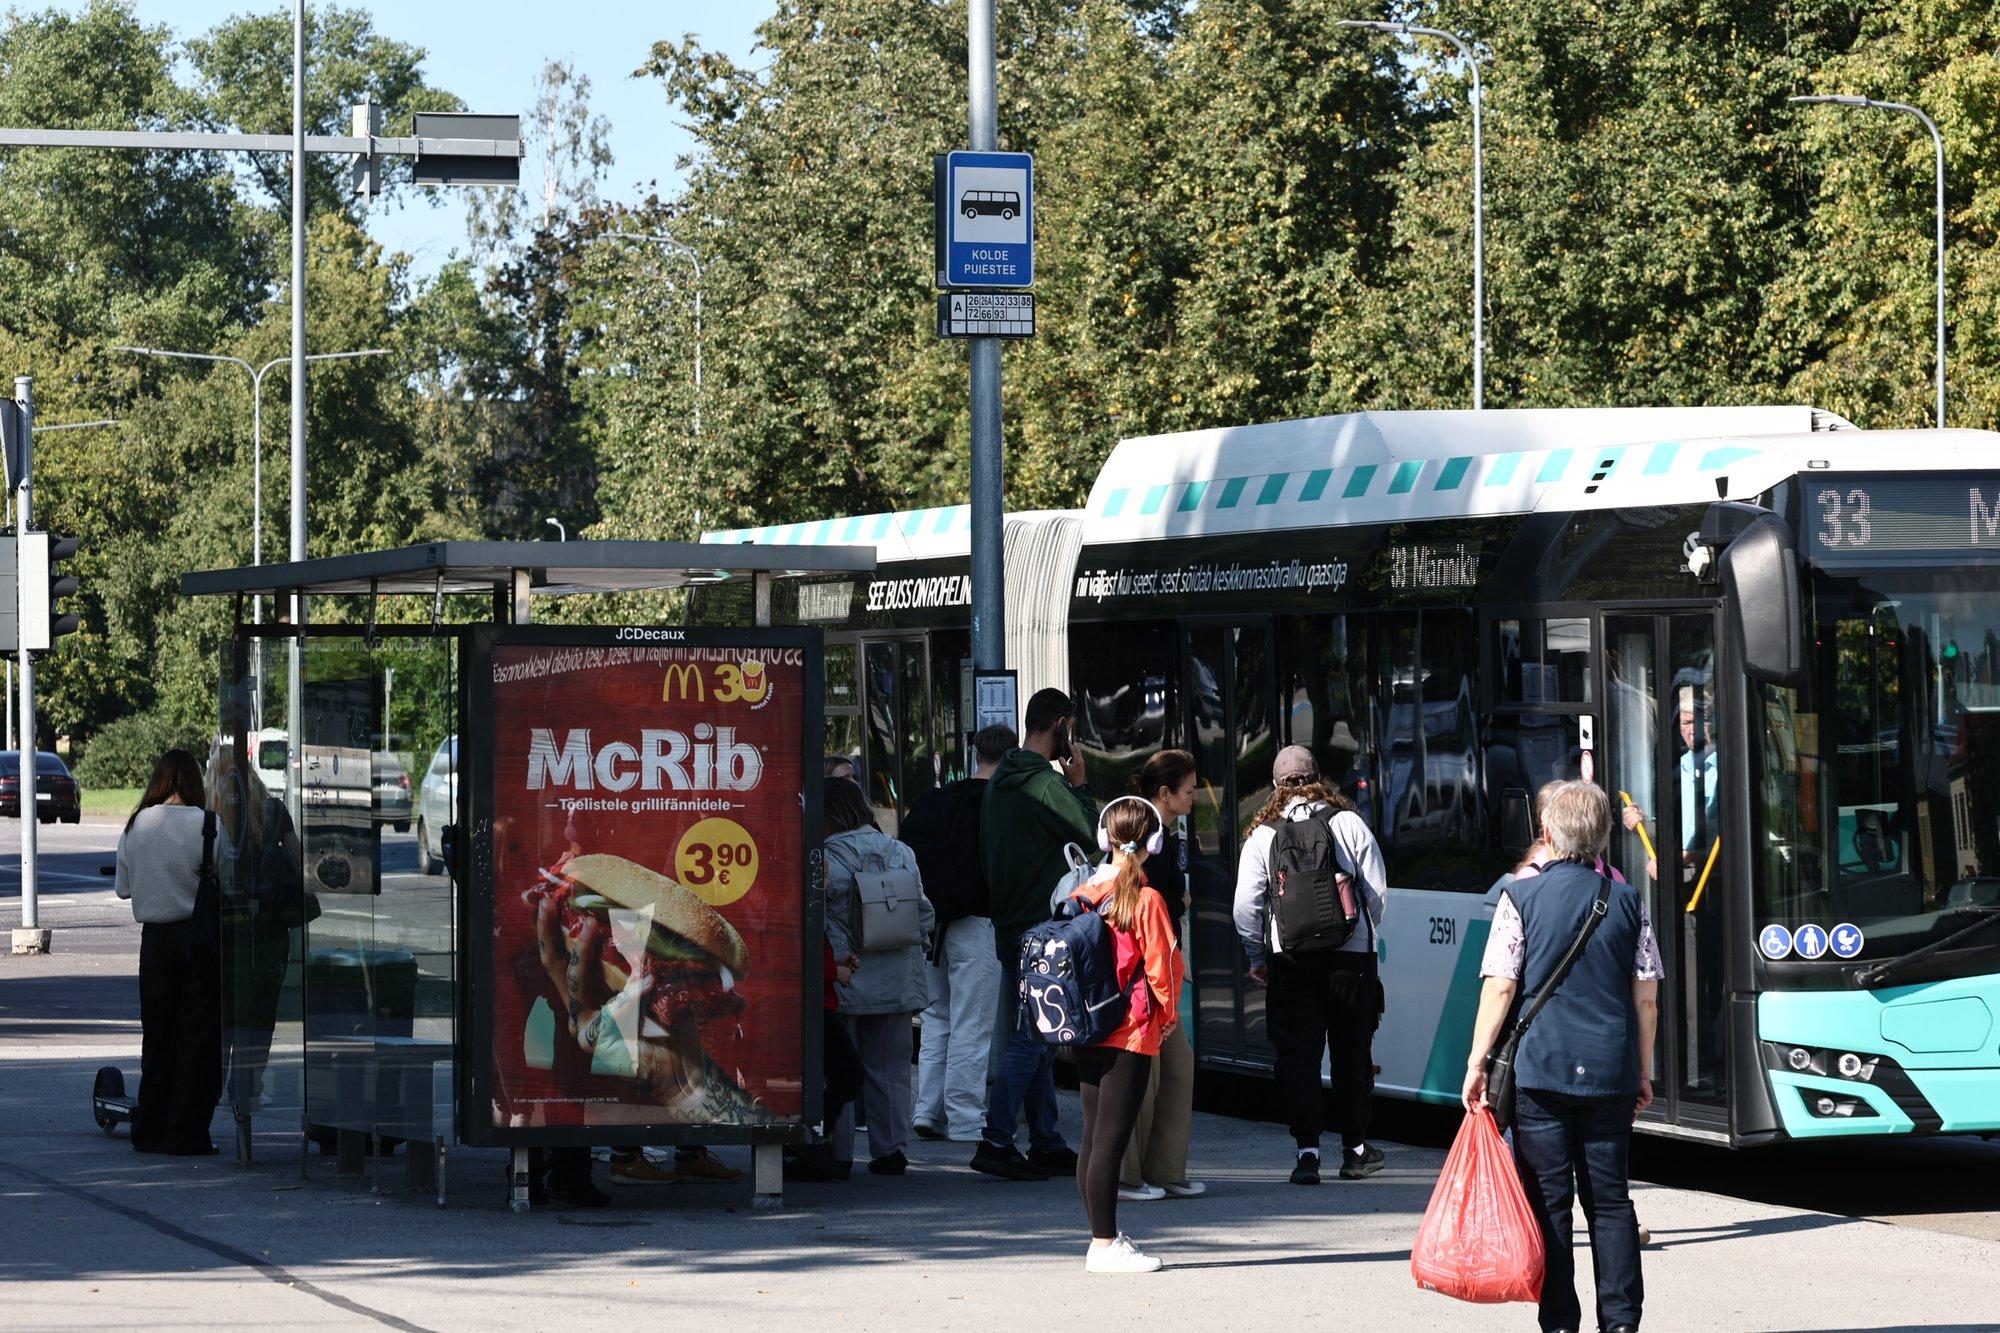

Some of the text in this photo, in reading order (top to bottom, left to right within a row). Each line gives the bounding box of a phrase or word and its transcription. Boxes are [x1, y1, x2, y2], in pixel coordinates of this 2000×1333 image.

[972, 249, 1009, 261] KOLDE
[964, 263, 1017, 275] PUIESTEE
[954, 301, 963, 312] A
[968, 296, 979, 306] 26
[981, 296, 993, 306] 26A
[994, 296, 1005, 306] 32
[1007, 296, 1018, 306] 33
[968, 308, 1005, 319] 72 66 93
[1817, 489, 1871, 546] 33
[1412, 543, 1480, 587] Männiku
[1117, 567, 1132, 596] kui
[1131, 568, 1158, 598] seest,
[1159, 567, 1181, 594] sest
[1180, 563, 1212, 593] sõidab
[1212, 558, 1306, 592] keskkonnasõbraliku
[1307, 556, 1348, 594] gaasiga
[866, 574, 972, 612] SEE BUSS ON ROHELIN
[615, 627, 686, 640] JCDecaux
[526, 722, 764, 793] McRib
[559, 797, 731, 814] Tõelistele grillifännidele
[1429, 916, 1457, 946] 2591
